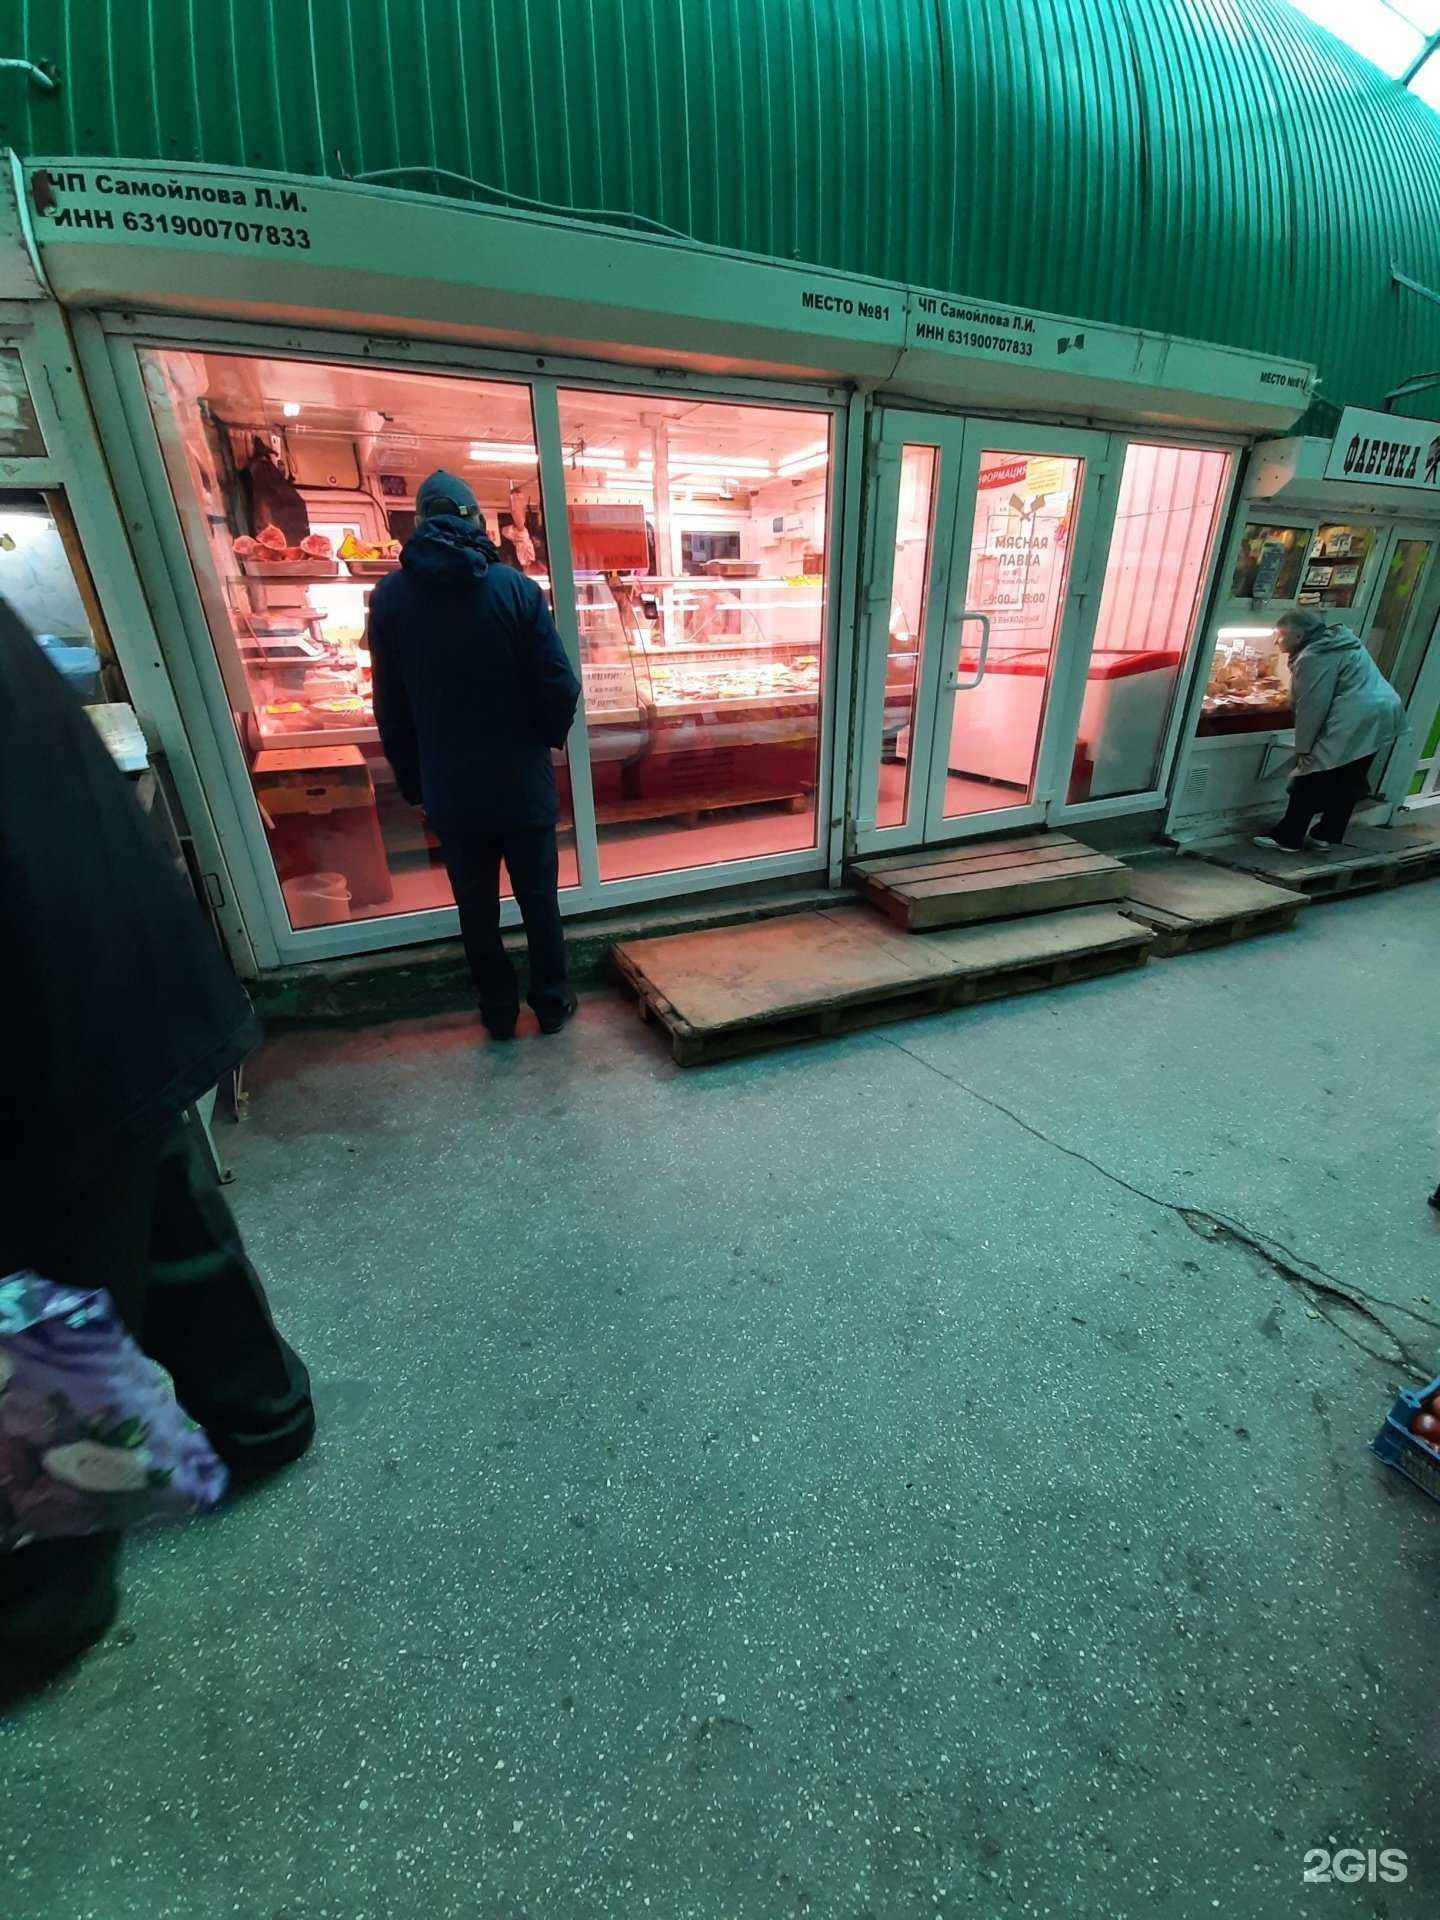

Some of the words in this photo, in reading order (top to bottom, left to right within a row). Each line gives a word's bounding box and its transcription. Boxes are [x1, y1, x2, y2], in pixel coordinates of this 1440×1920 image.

[48, 173, 86, 193] ЧП
[95, 174, 247, 206] Самойлова
[254, 187, 309, 213] Л.И.
[54, 208, 114, 230] ИНН
[122, 211, 312, 250] 631900707833
[801, 291, 854, 315] МЕСТО
[857, 301, 890, 322] №81
[917, 296, 937, 314] ЧП
[940, 303, 1010, 328] Самойлова
[1012, 317, 1036, 334] Л.И.
[915, 322, 945, 343] ИНН
[947, 330, 1034, 357] 631900707833
[1260, 371, 1287, 386] МЕСТО
[1343, 432, 1422, 480] ФАБРИКА
[994, 535, 1049, 549] МЯСНАЯ
[998, 553, 1041, 567] ЛАВКА
